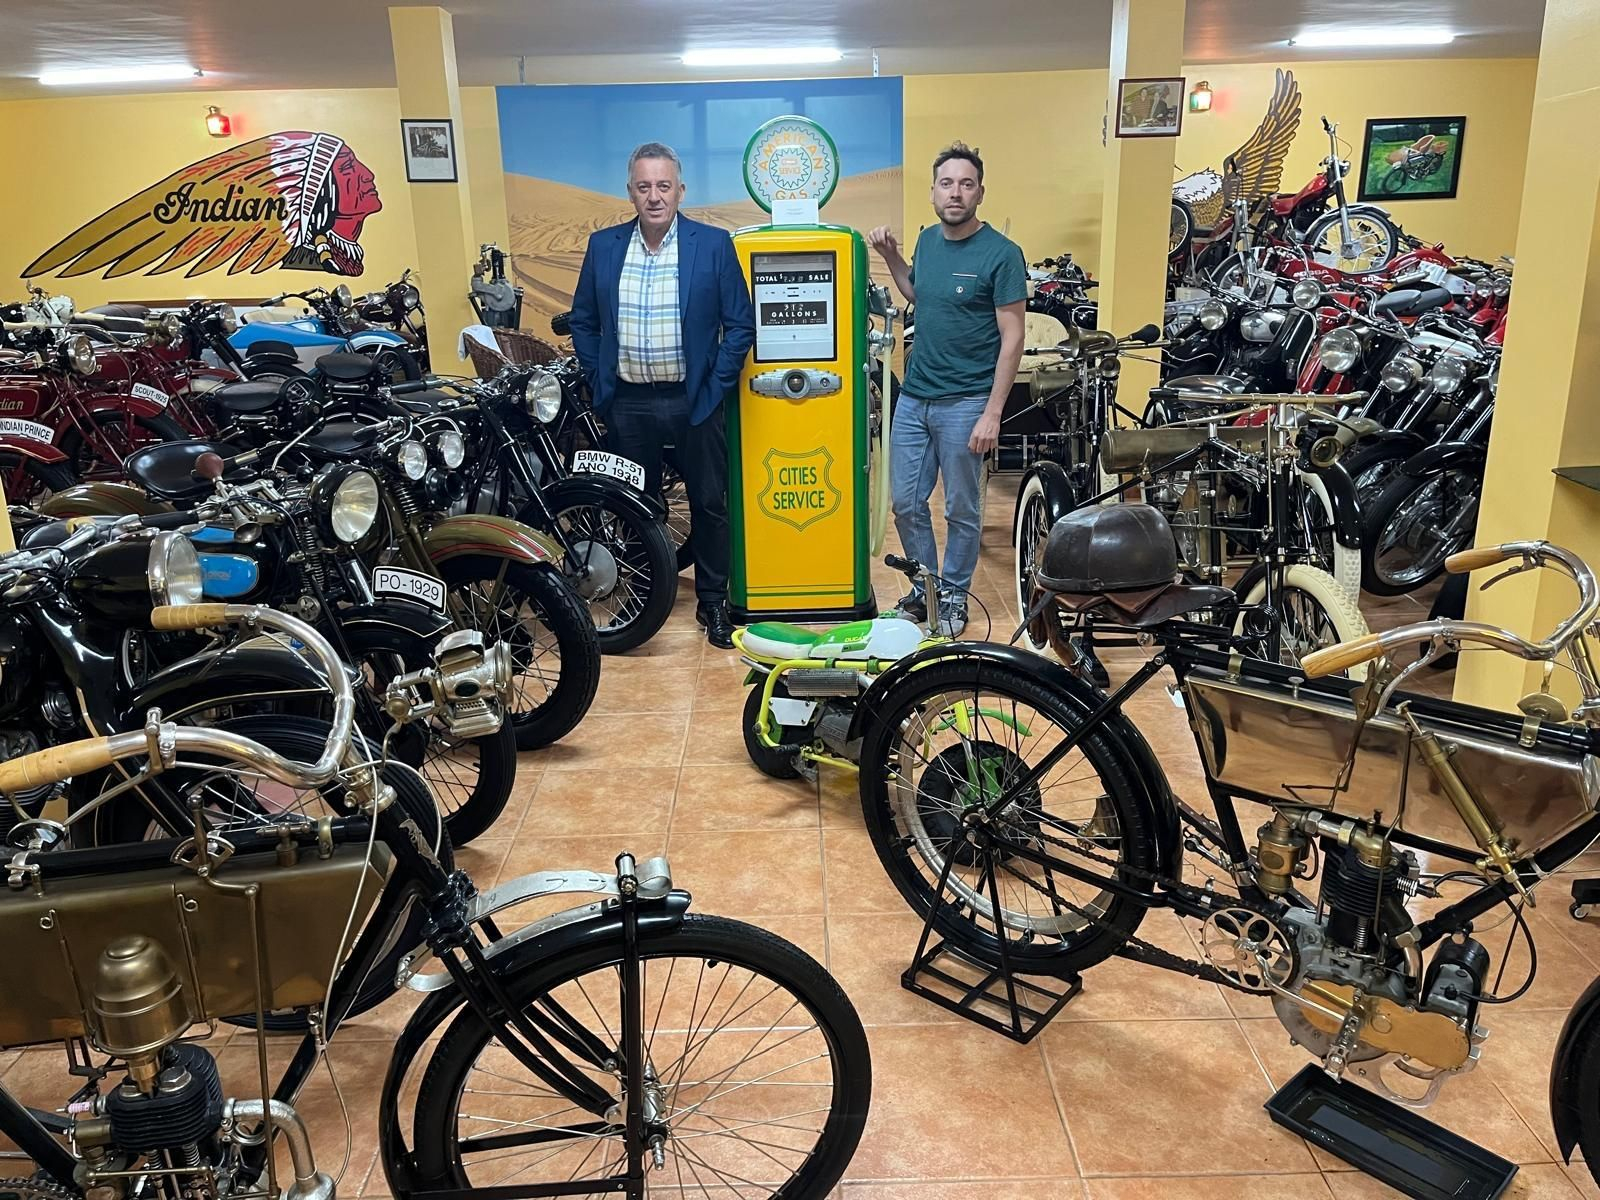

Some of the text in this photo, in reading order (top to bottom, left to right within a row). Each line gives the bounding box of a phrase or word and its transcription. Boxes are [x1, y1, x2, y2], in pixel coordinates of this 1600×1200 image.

[153, 182, 289, 224] Indian
[775, 189, 808, 200] GAS
[808, 273, 829, 281] SALE
[771, 310, 817, 318] GALLONS
[134, 385, 168, 404] SCOUT-1925
[0, 398, 24, 410] dian
[24, 423, 51, 440] PRINCE
[578, 452, 642, 476] BMW R-51
[612, 467, 640, 485] 1938
[779, 466, 817, 486] CITIES
[773, 490, 825, 510] SERVICE
